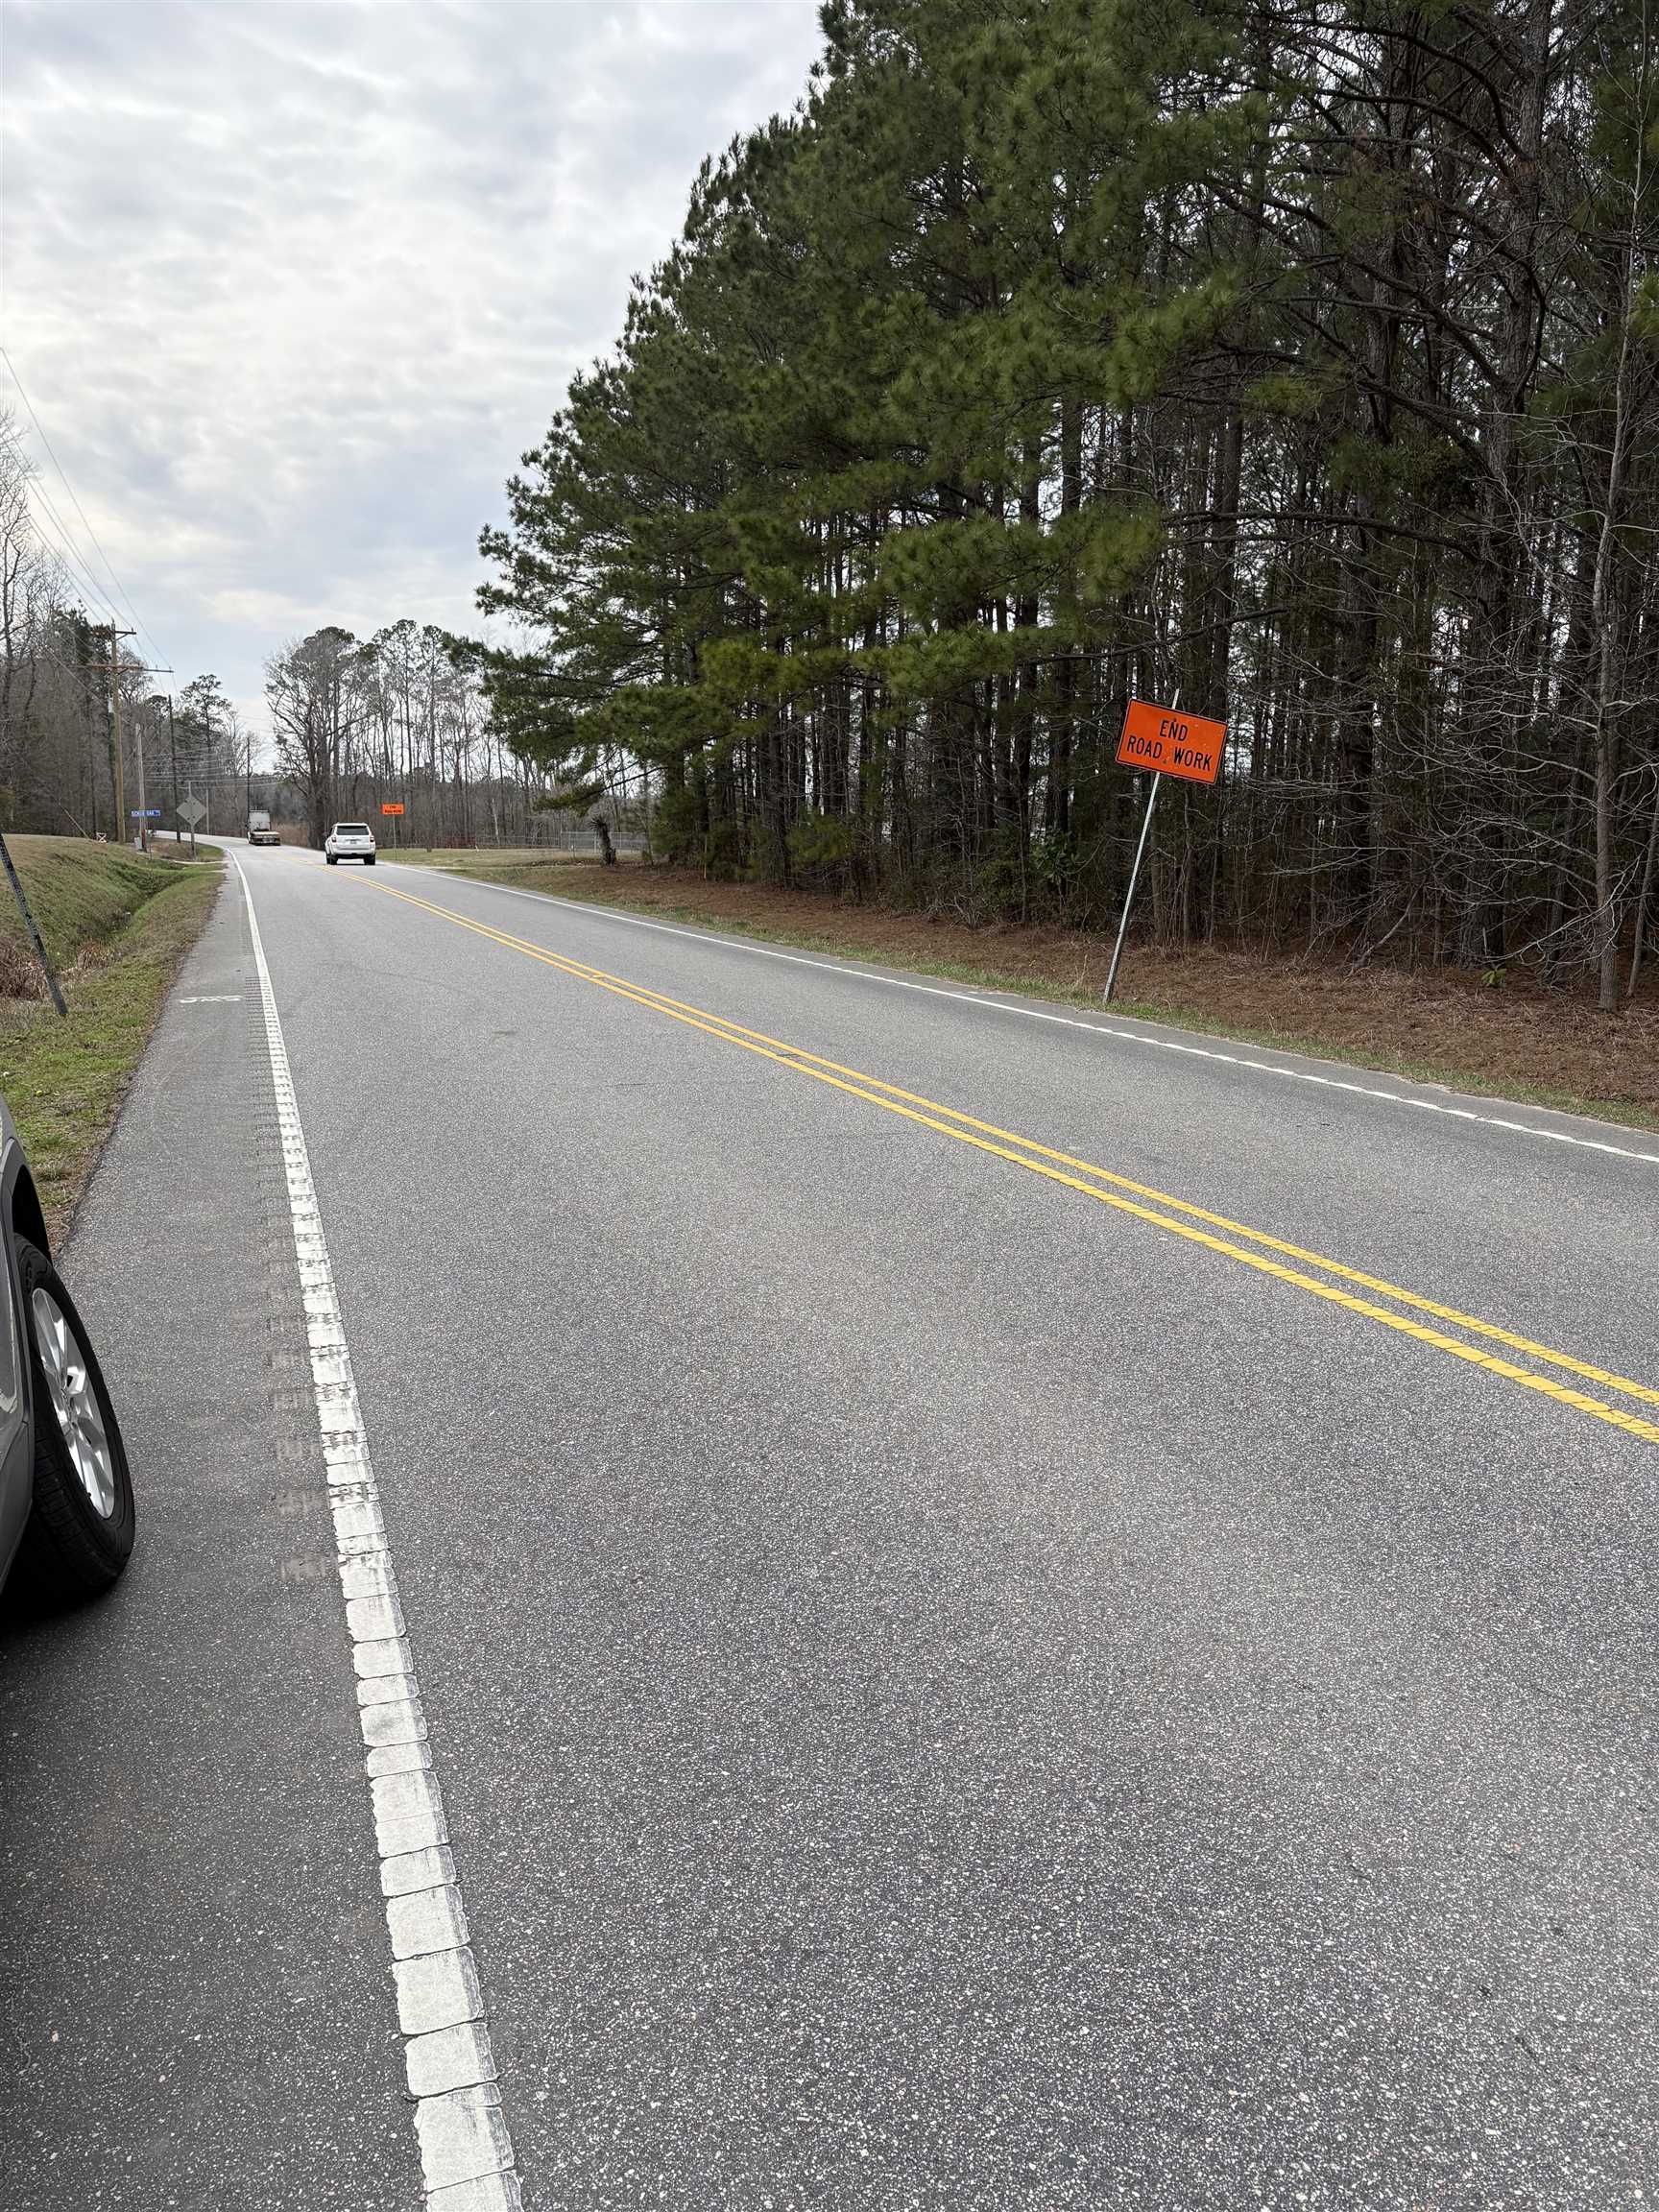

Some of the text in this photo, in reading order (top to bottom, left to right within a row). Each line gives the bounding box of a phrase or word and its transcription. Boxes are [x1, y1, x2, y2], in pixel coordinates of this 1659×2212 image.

[1159, 719, 1189, 741] END
[1127, 734, 1213, 771] ROAD WORK
